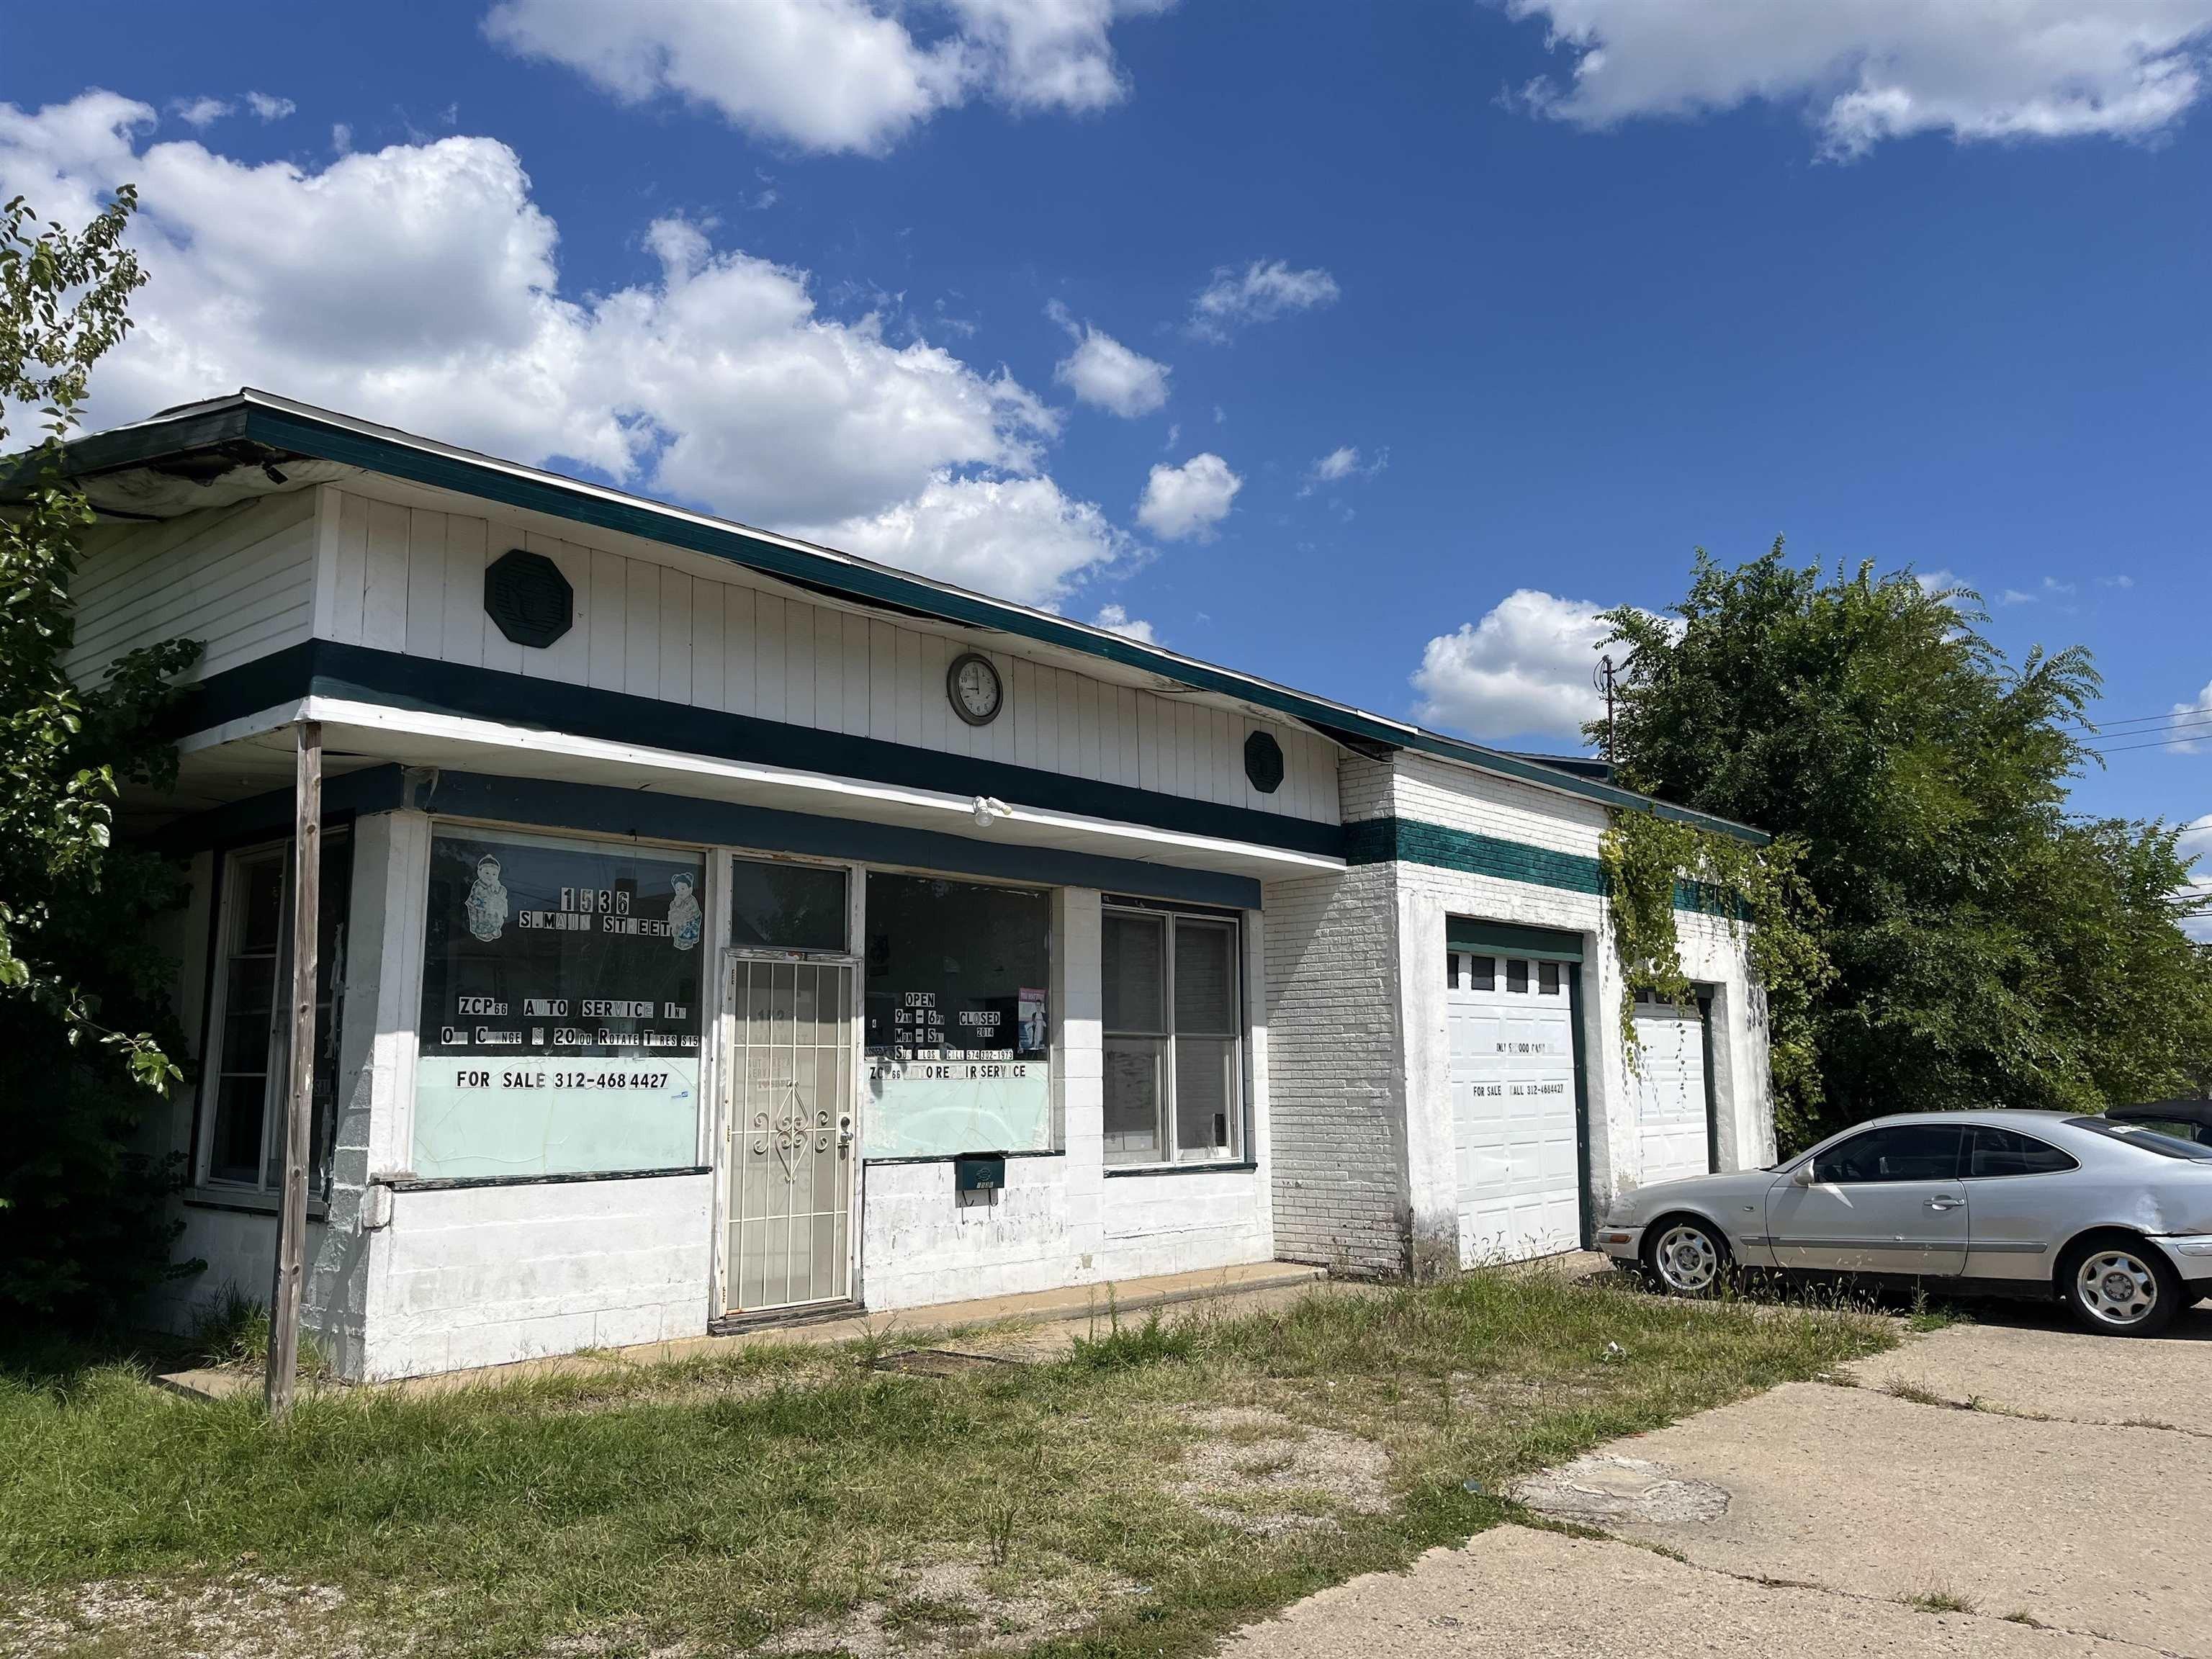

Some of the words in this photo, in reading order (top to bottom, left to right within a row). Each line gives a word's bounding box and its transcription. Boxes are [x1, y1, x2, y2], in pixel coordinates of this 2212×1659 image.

[564, 889, 628, 914] 1536
[604, 917, 670, 935] STREET
[907, 994, 935, 1006] OPEN
[524, 1000, 567, 1015] AUTO
[583, 1000, 653, 1017] SERVICE
[960, 1012, 1000, 1025] CLOSED
[599, 1029, 639, 1045] ROTATE
[976, 1028, 994, 1037] 2014
[457, 1071, 490, 1087] FOR
[503, 1072, 546, 1088] SALE
[1473, 1086, 1485, 1097] FOR
[1487, 1085, 1501, 1096] SALE
